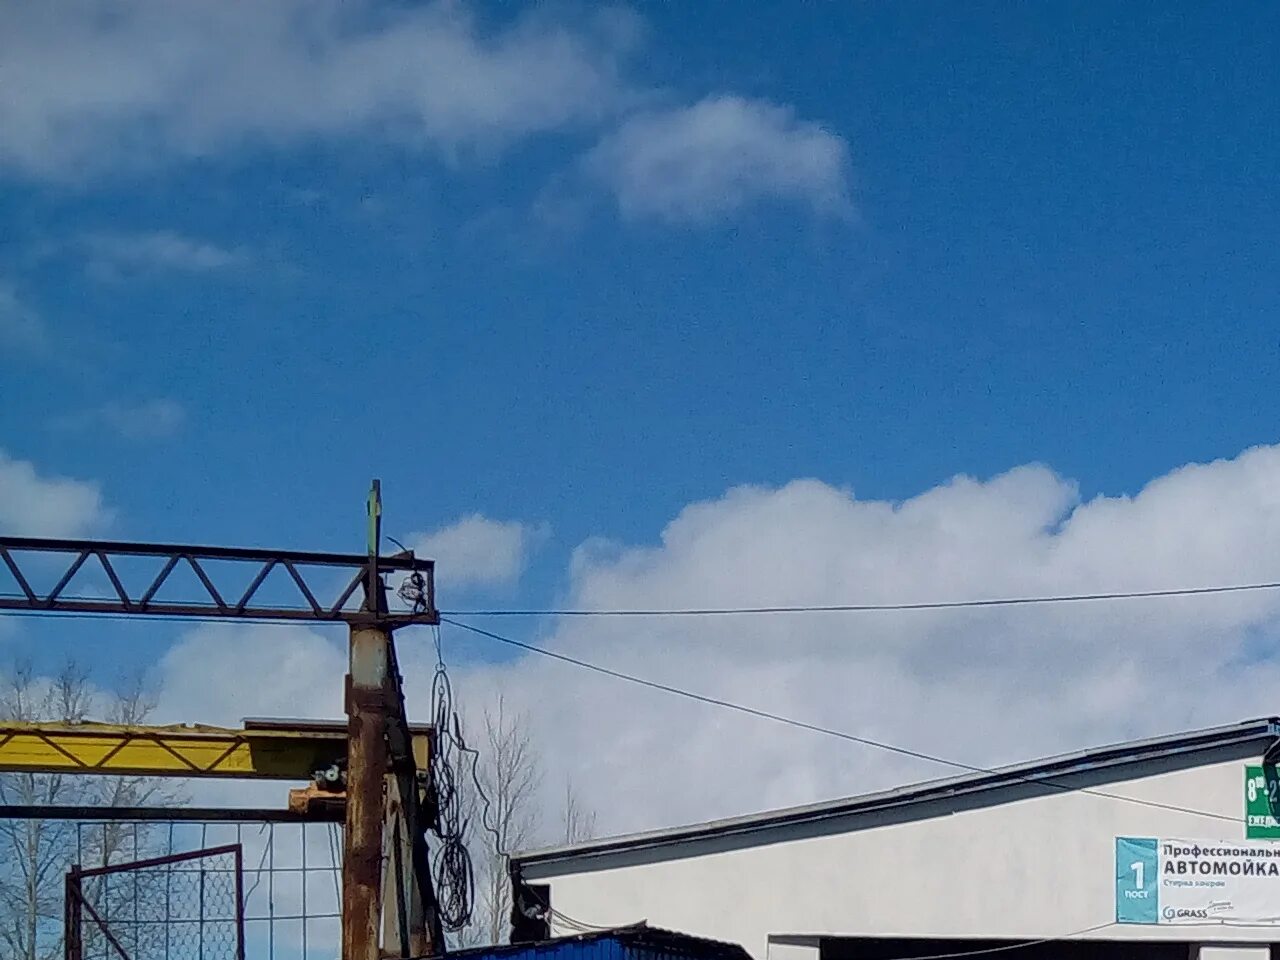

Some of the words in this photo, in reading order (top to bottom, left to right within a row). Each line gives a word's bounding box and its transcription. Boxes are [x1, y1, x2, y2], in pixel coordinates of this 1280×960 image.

[1130, 861, 1144, 890] 1
[1163, 859, 1280, 877] АВТОМОЙКА
[1176, 908, 1208, 919] GRASS
